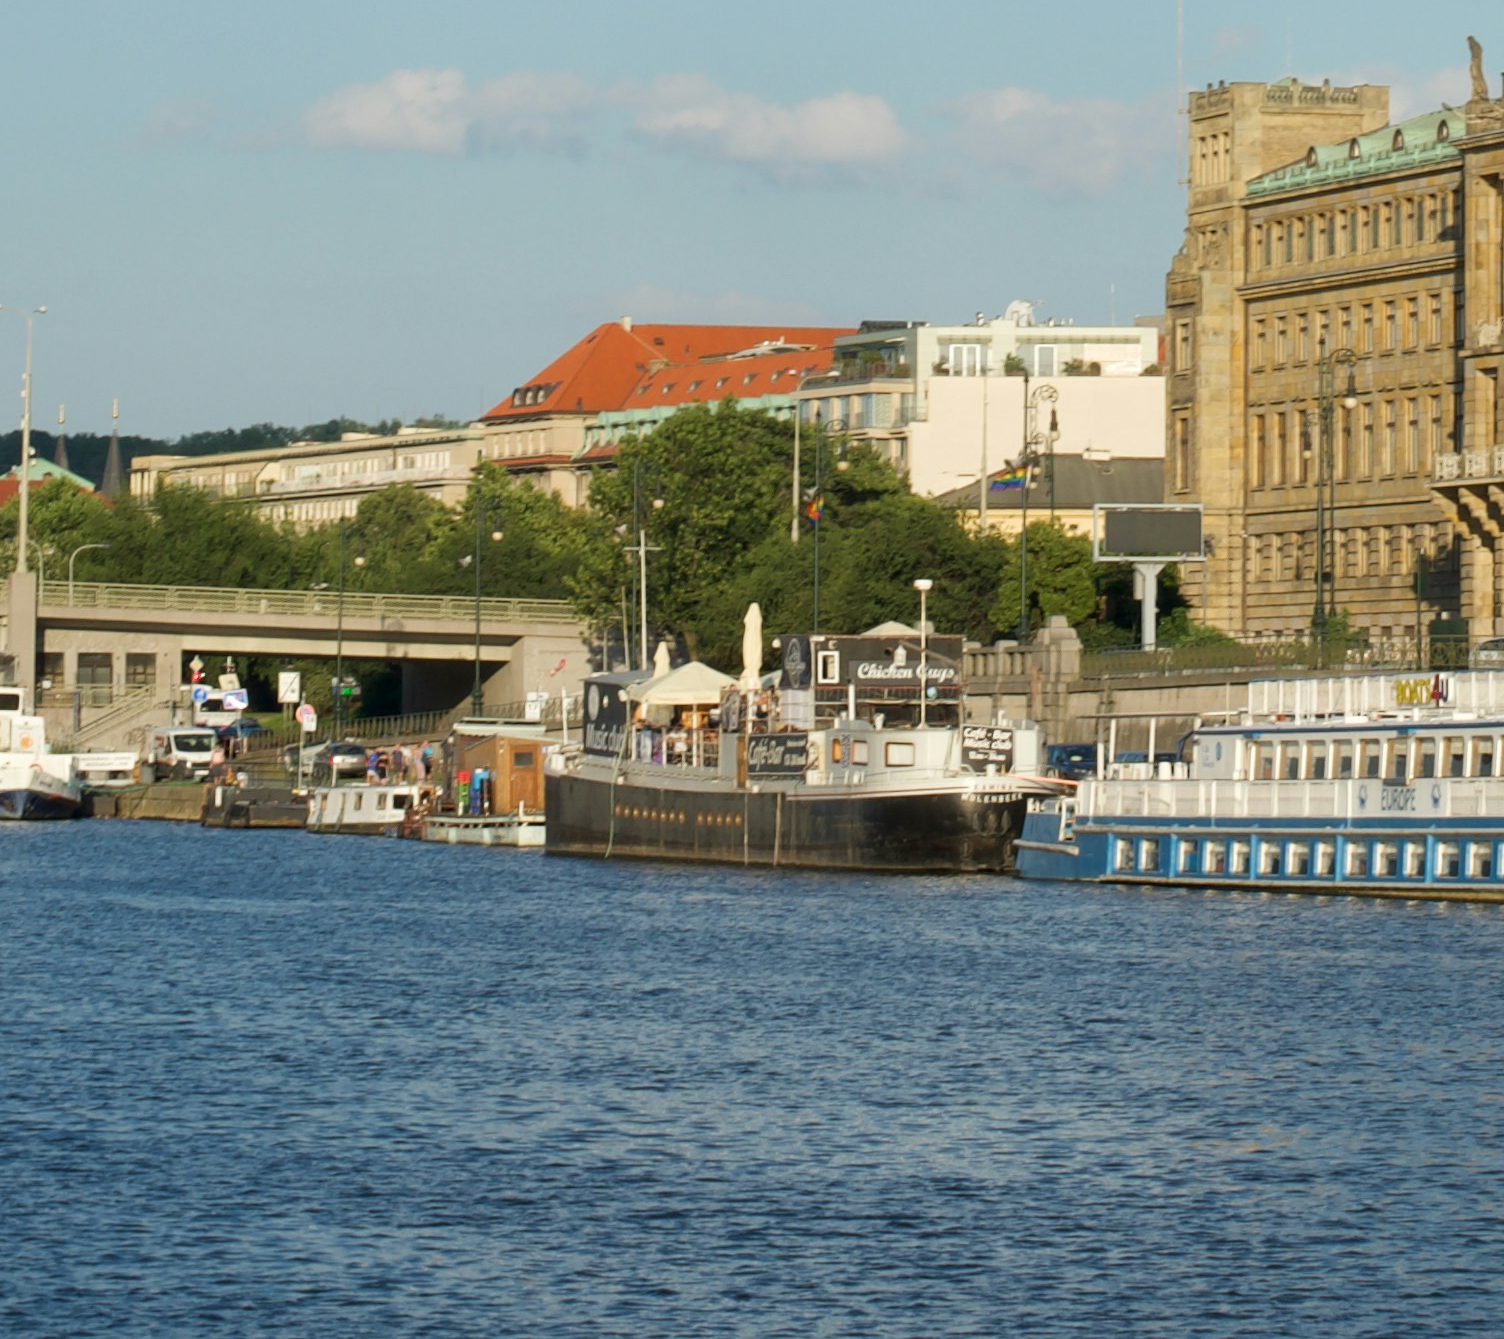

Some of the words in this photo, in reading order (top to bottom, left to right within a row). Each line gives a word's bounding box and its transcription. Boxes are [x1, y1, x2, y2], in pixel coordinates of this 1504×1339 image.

[857, 662, 913, 679] Chicken
[586, 723, 608, 749] Music
[1381, 788, 1416, 811] EUROPE
